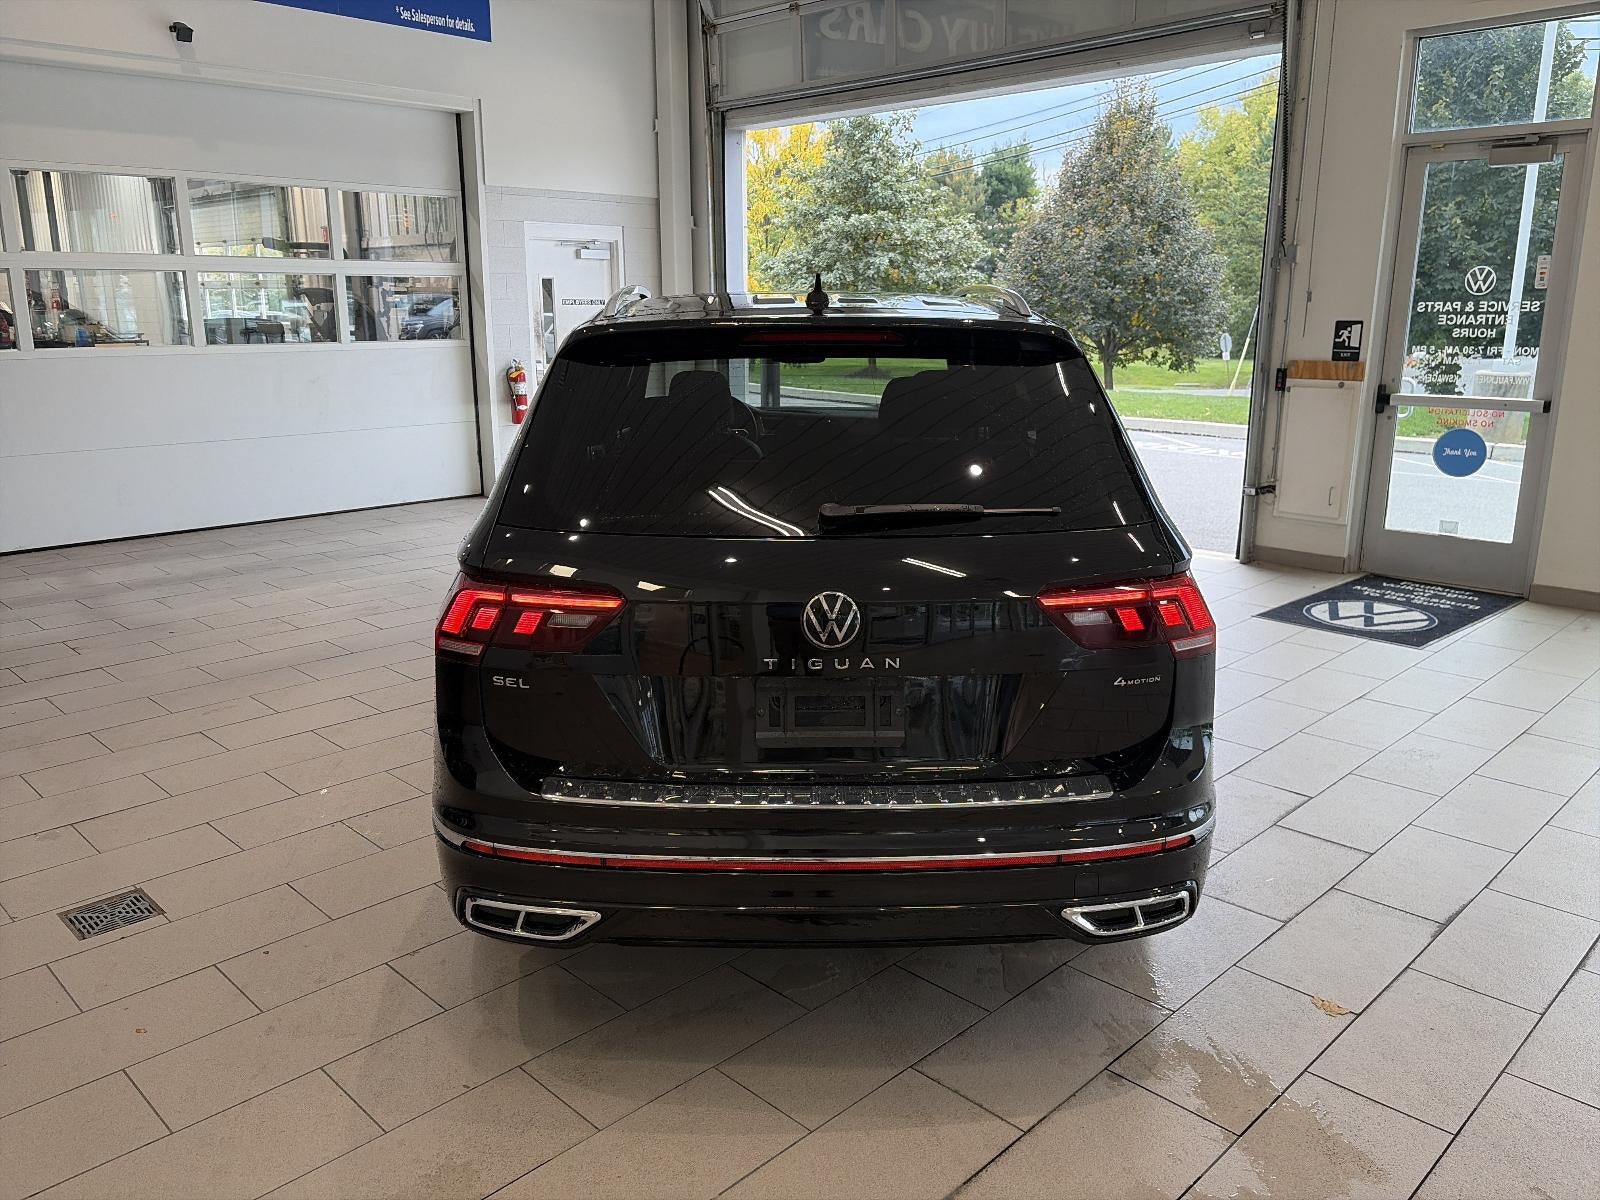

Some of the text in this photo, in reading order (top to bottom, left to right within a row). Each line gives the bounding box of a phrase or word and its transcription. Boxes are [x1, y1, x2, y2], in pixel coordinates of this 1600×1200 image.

[400, 6, 476, 32] See Salesperson for details.
[1442, 447, 1477, 458] Thank You
[763, 657, 901, 670] TIGUAN
[492, 675, 530, 689] SEL
[1113, 676, 1161, 687] 4MOTION
